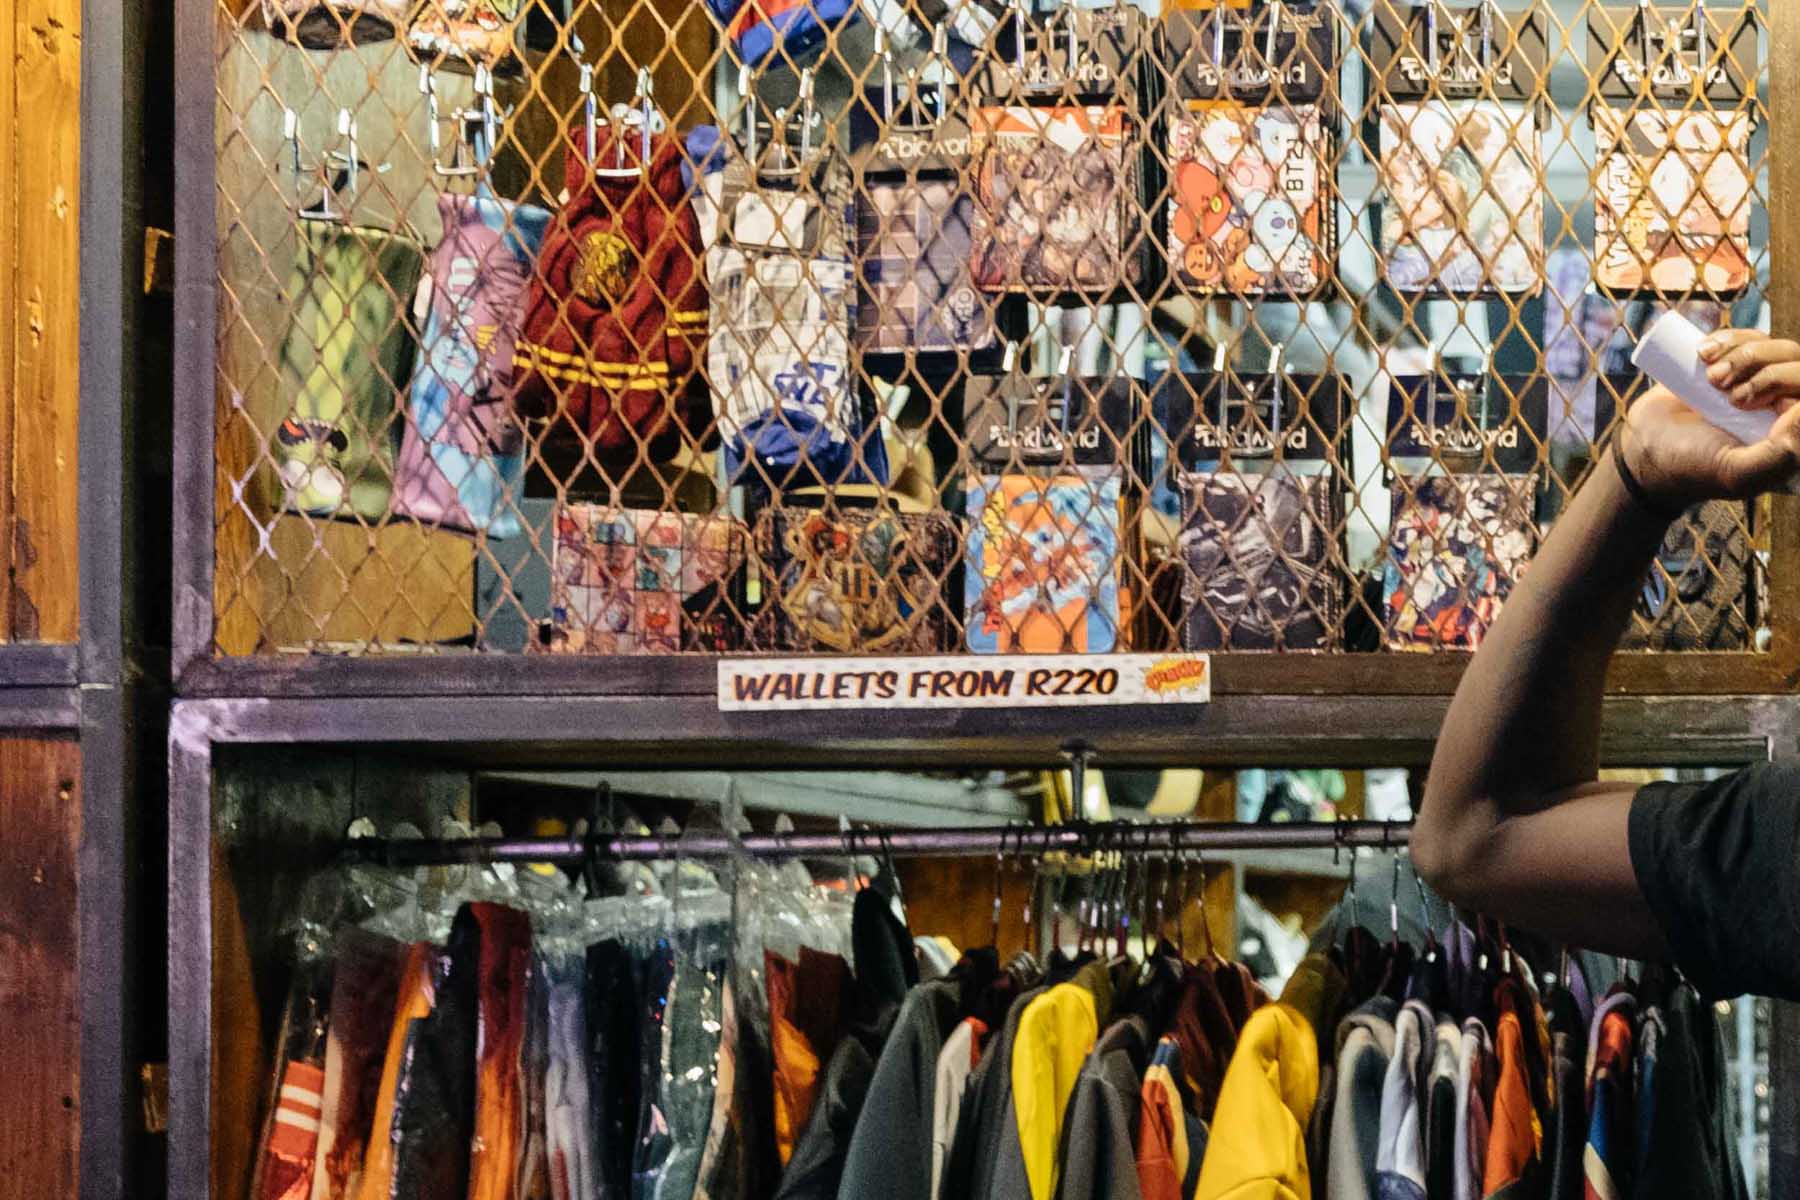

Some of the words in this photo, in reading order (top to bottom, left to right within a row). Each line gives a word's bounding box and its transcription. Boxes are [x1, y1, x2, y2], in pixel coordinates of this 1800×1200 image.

[897, 135, 973, 158] bioworl
[1286, 138, 1304, 191] BT21
[1216, 426, 1307, 449] biowld
[733, 669, 898, 700] WALLETS
[907, 670, 1013, 698] FROM
[1025, 668, 1119, 696] R220
